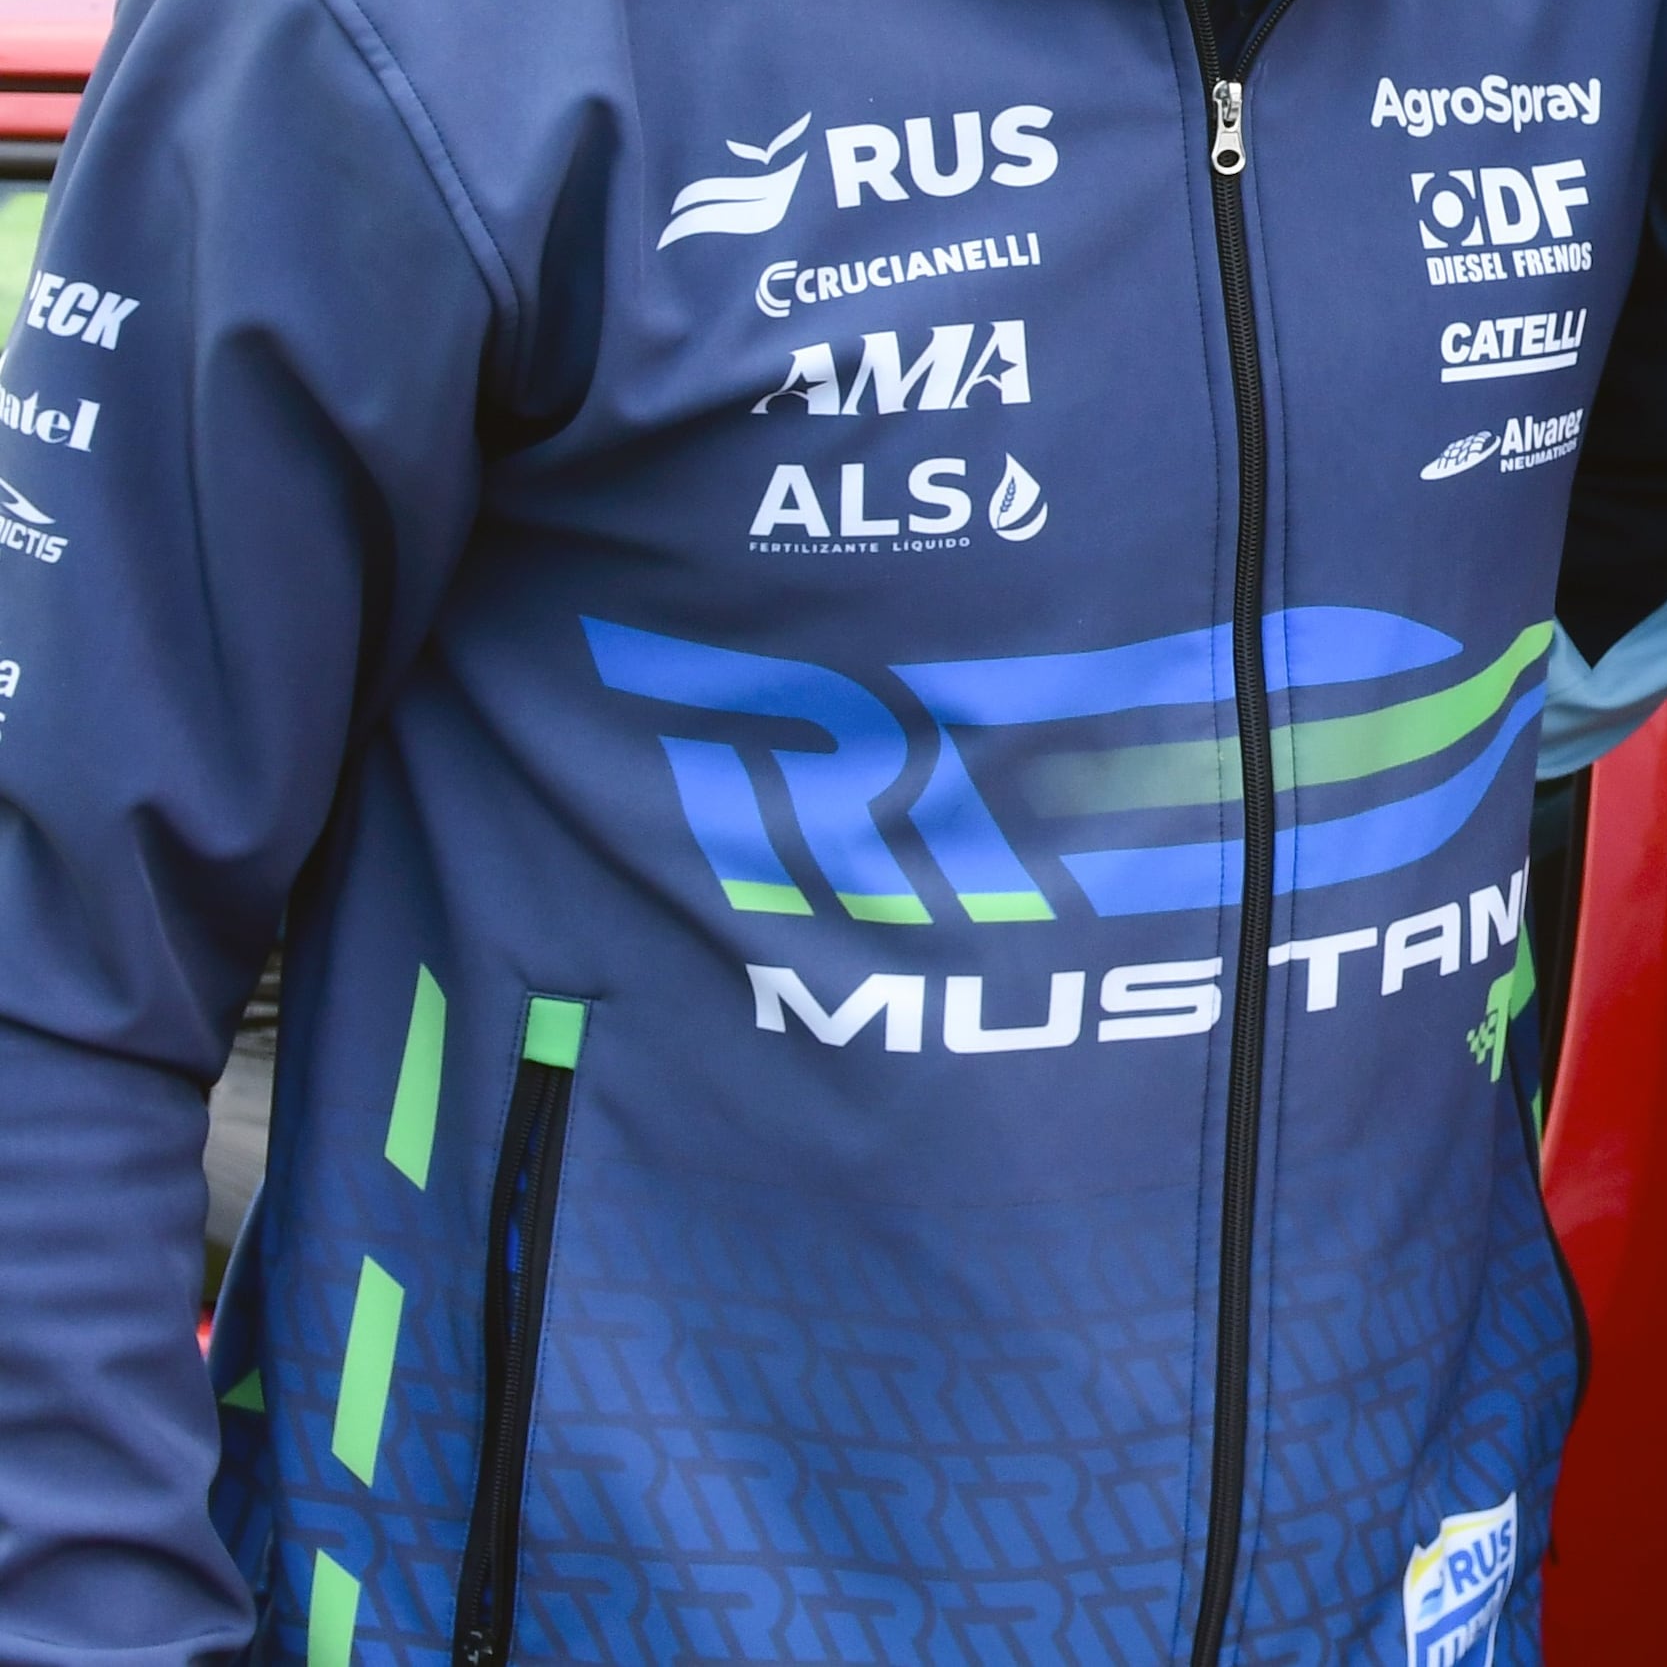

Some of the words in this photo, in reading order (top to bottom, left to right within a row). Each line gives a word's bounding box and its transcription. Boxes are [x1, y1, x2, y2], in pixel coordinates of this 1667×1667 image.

[1371, 75, 1601, 137] AgroSpray
[825, 105, 1059, 209] RUS
[1480, 159, 1590, 246] DF
[795, 233, 1041, 303] CRUCIANELLI
[1426, 252, 1507, 285] DIESEL
[1513, 243, 1592, 278] FRENOS
[27, 269, 140, 351] ECK
[1441, 308, 1587, 363] CATELLI
[751, 320, 1031, 415] AMA
[1500, 408, 1583, 456] Alvarez
[749, 457, 973, 538] ALS
[749, 541, 879, 555] FERTILIZANTE
[744, 856, 1530, 1055] MUSTAN
[1449, 1519, 1511, 1595] RUS
